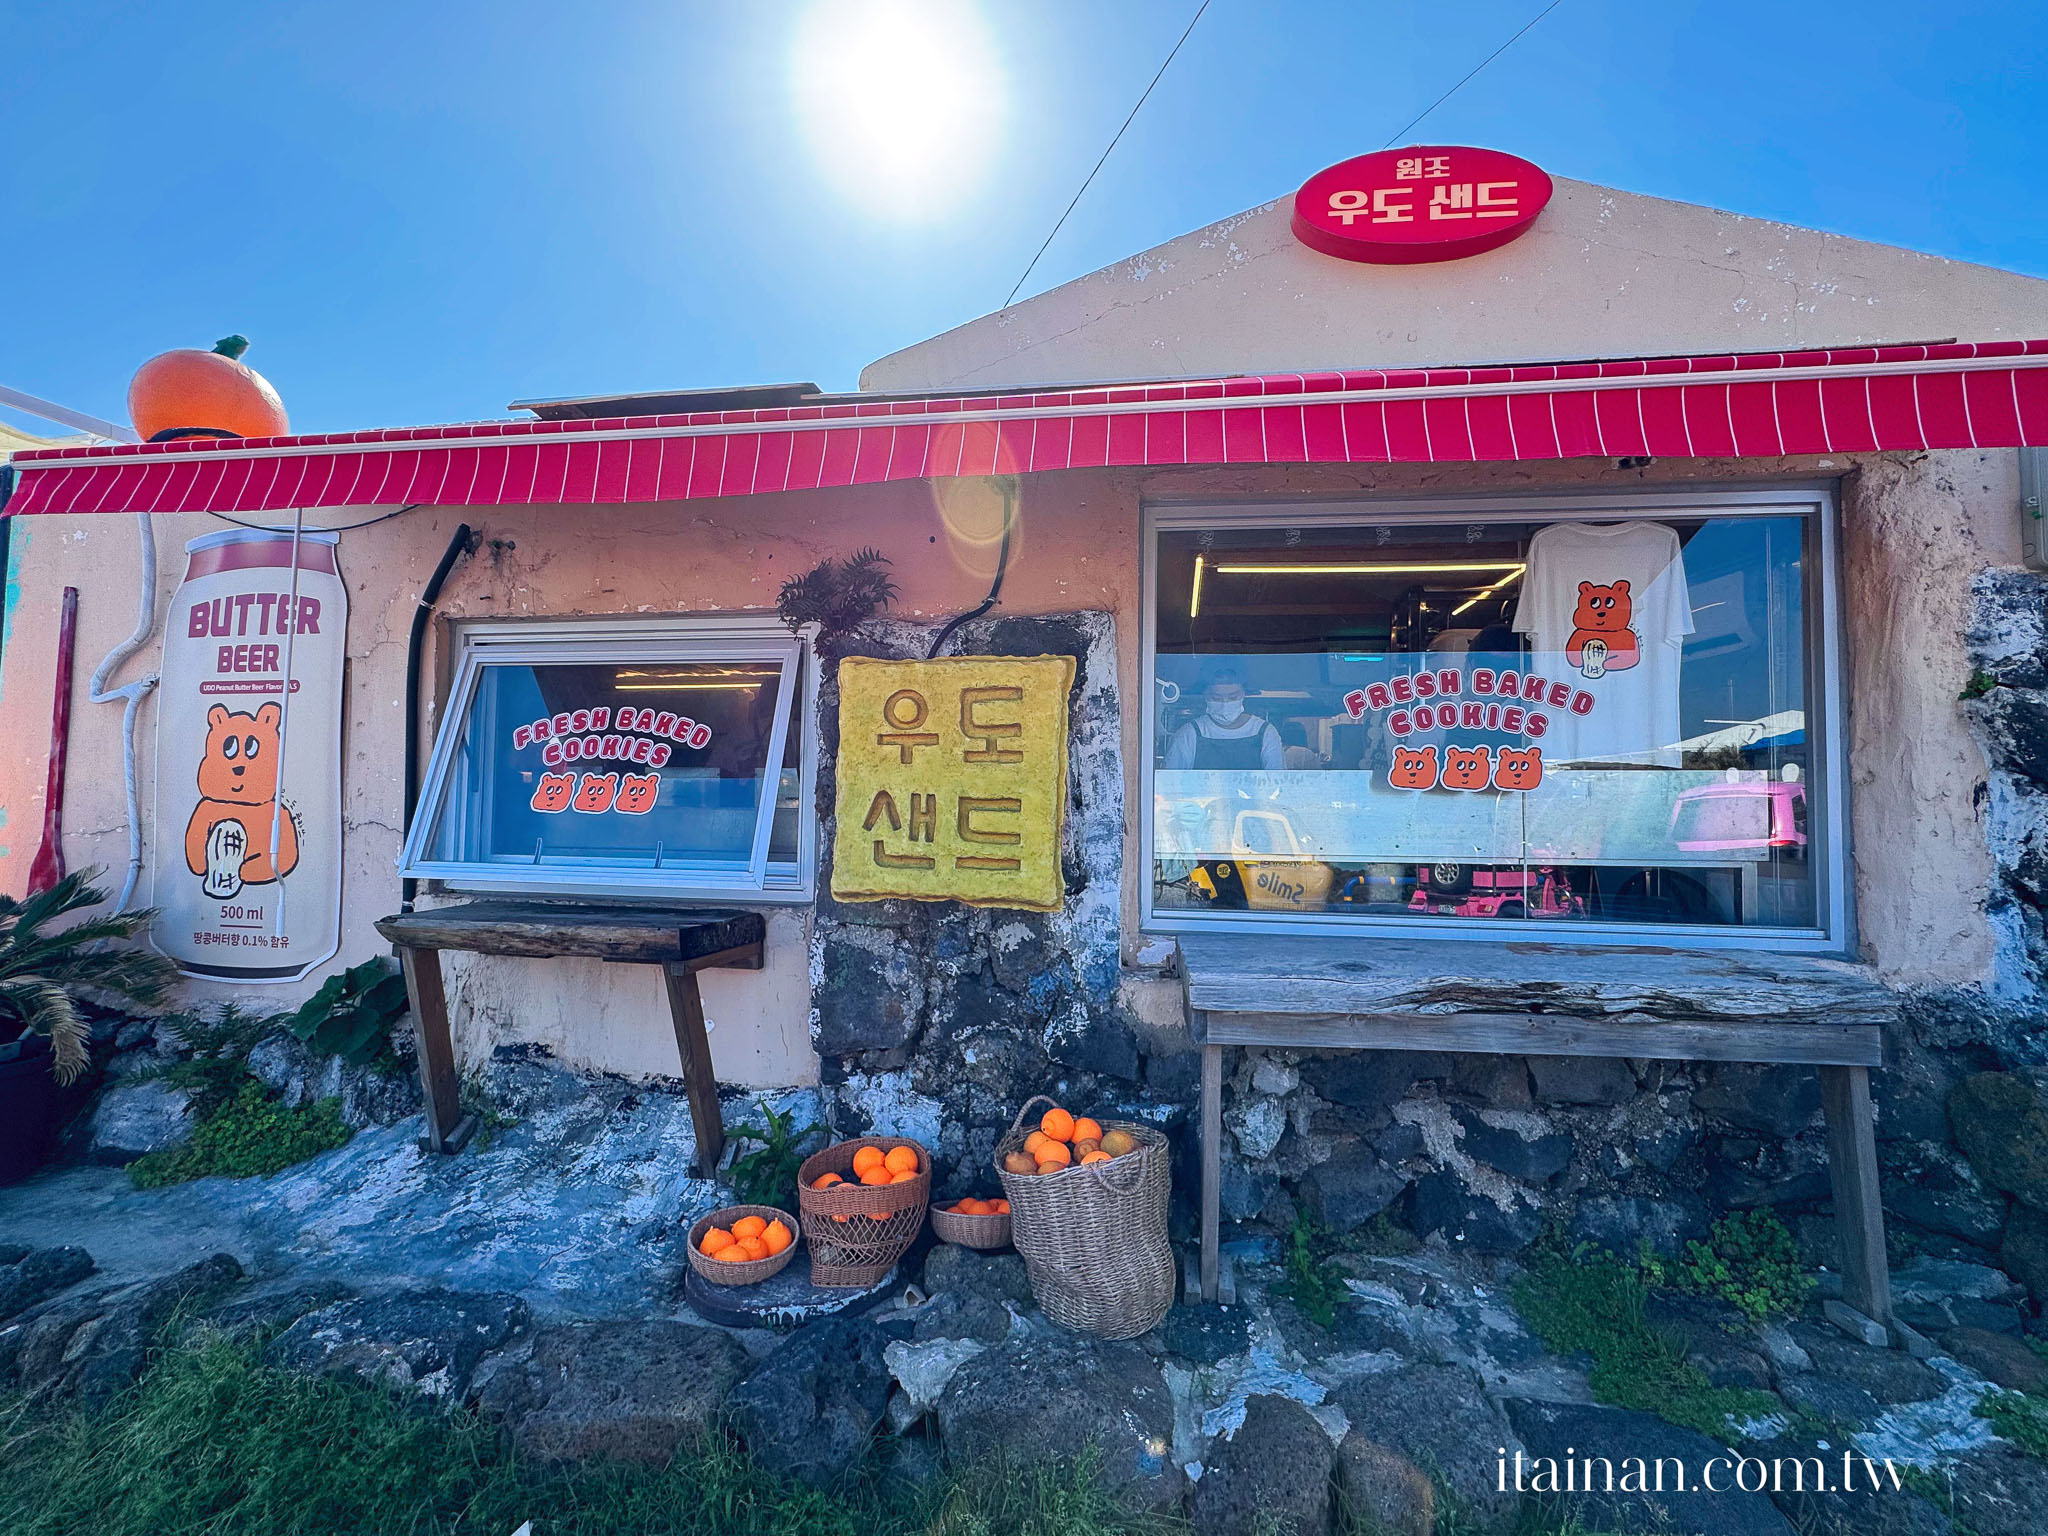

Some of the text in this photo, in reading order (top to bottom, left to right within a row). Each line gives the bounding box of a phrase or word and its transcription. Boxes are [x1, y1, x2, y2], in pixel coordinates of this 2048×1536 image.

[1396, 156, 1450, 180] 원조
[1327, 181, 1519, 225] 우도 샌드
[188, 592, 321, 638] BUTTER
[217, 644, 280, 673] BEER
[203, 684, 215, 692] UDO
[265, 682, 283, 691] Flavor
[1344, 669, 1595, 718] FRESH BAKED
[513, 707, 712, 750] FRESH BAKED
[877, 686, 1023, 765] 우도
[1389, 702, 1549, 737] COOKIES
[543, 735, 671, 768] COOKIES
[862, 789, 1022, 871] 샌드
[220, 905, 264, 920] 500 ml
[193, 931, 290, 949] 땅콩버터향 0.1% 함유
